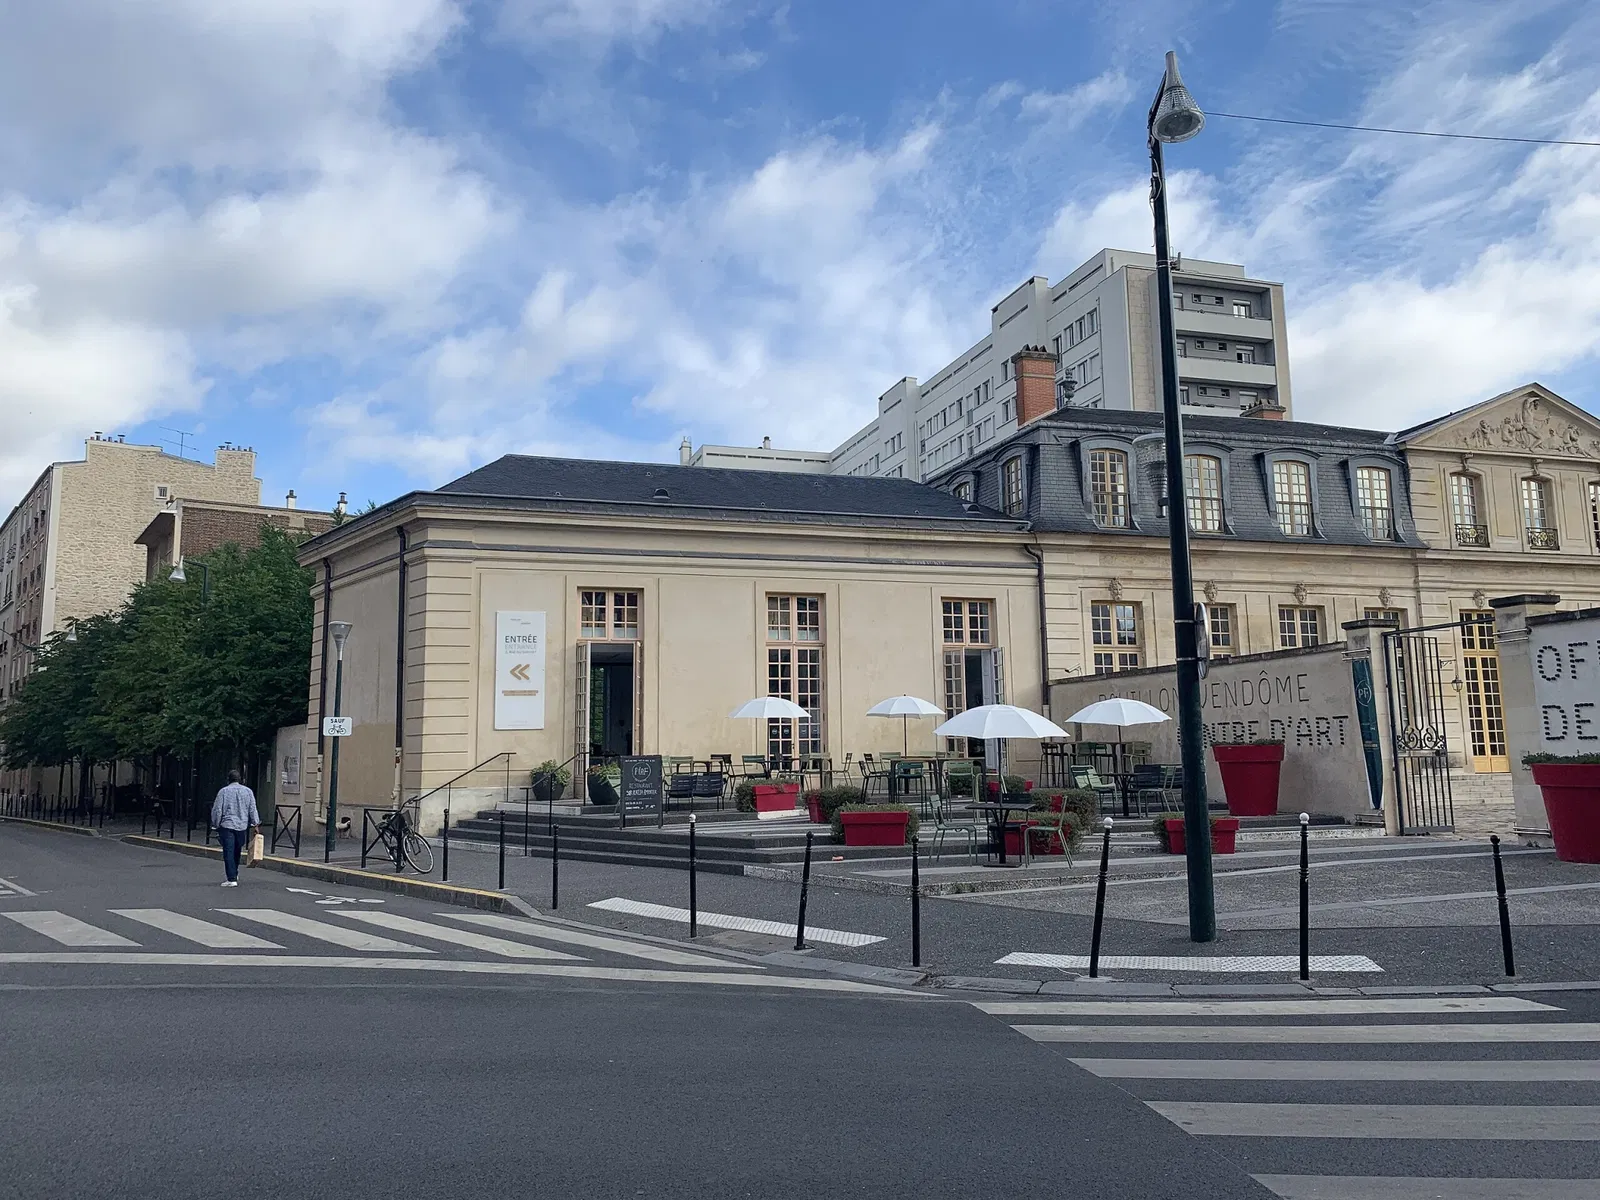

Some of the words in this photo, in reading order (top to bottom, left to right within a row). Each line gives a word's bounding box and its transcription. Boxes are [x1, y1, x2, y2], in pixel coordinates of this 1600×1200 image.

[505, 633, 538, 644] ENTRÉE
[1537, 641, 1600, 681] OF
[1270, 715, 1349, 746] D'ART
[1542, 702, 1598, 741] DE
